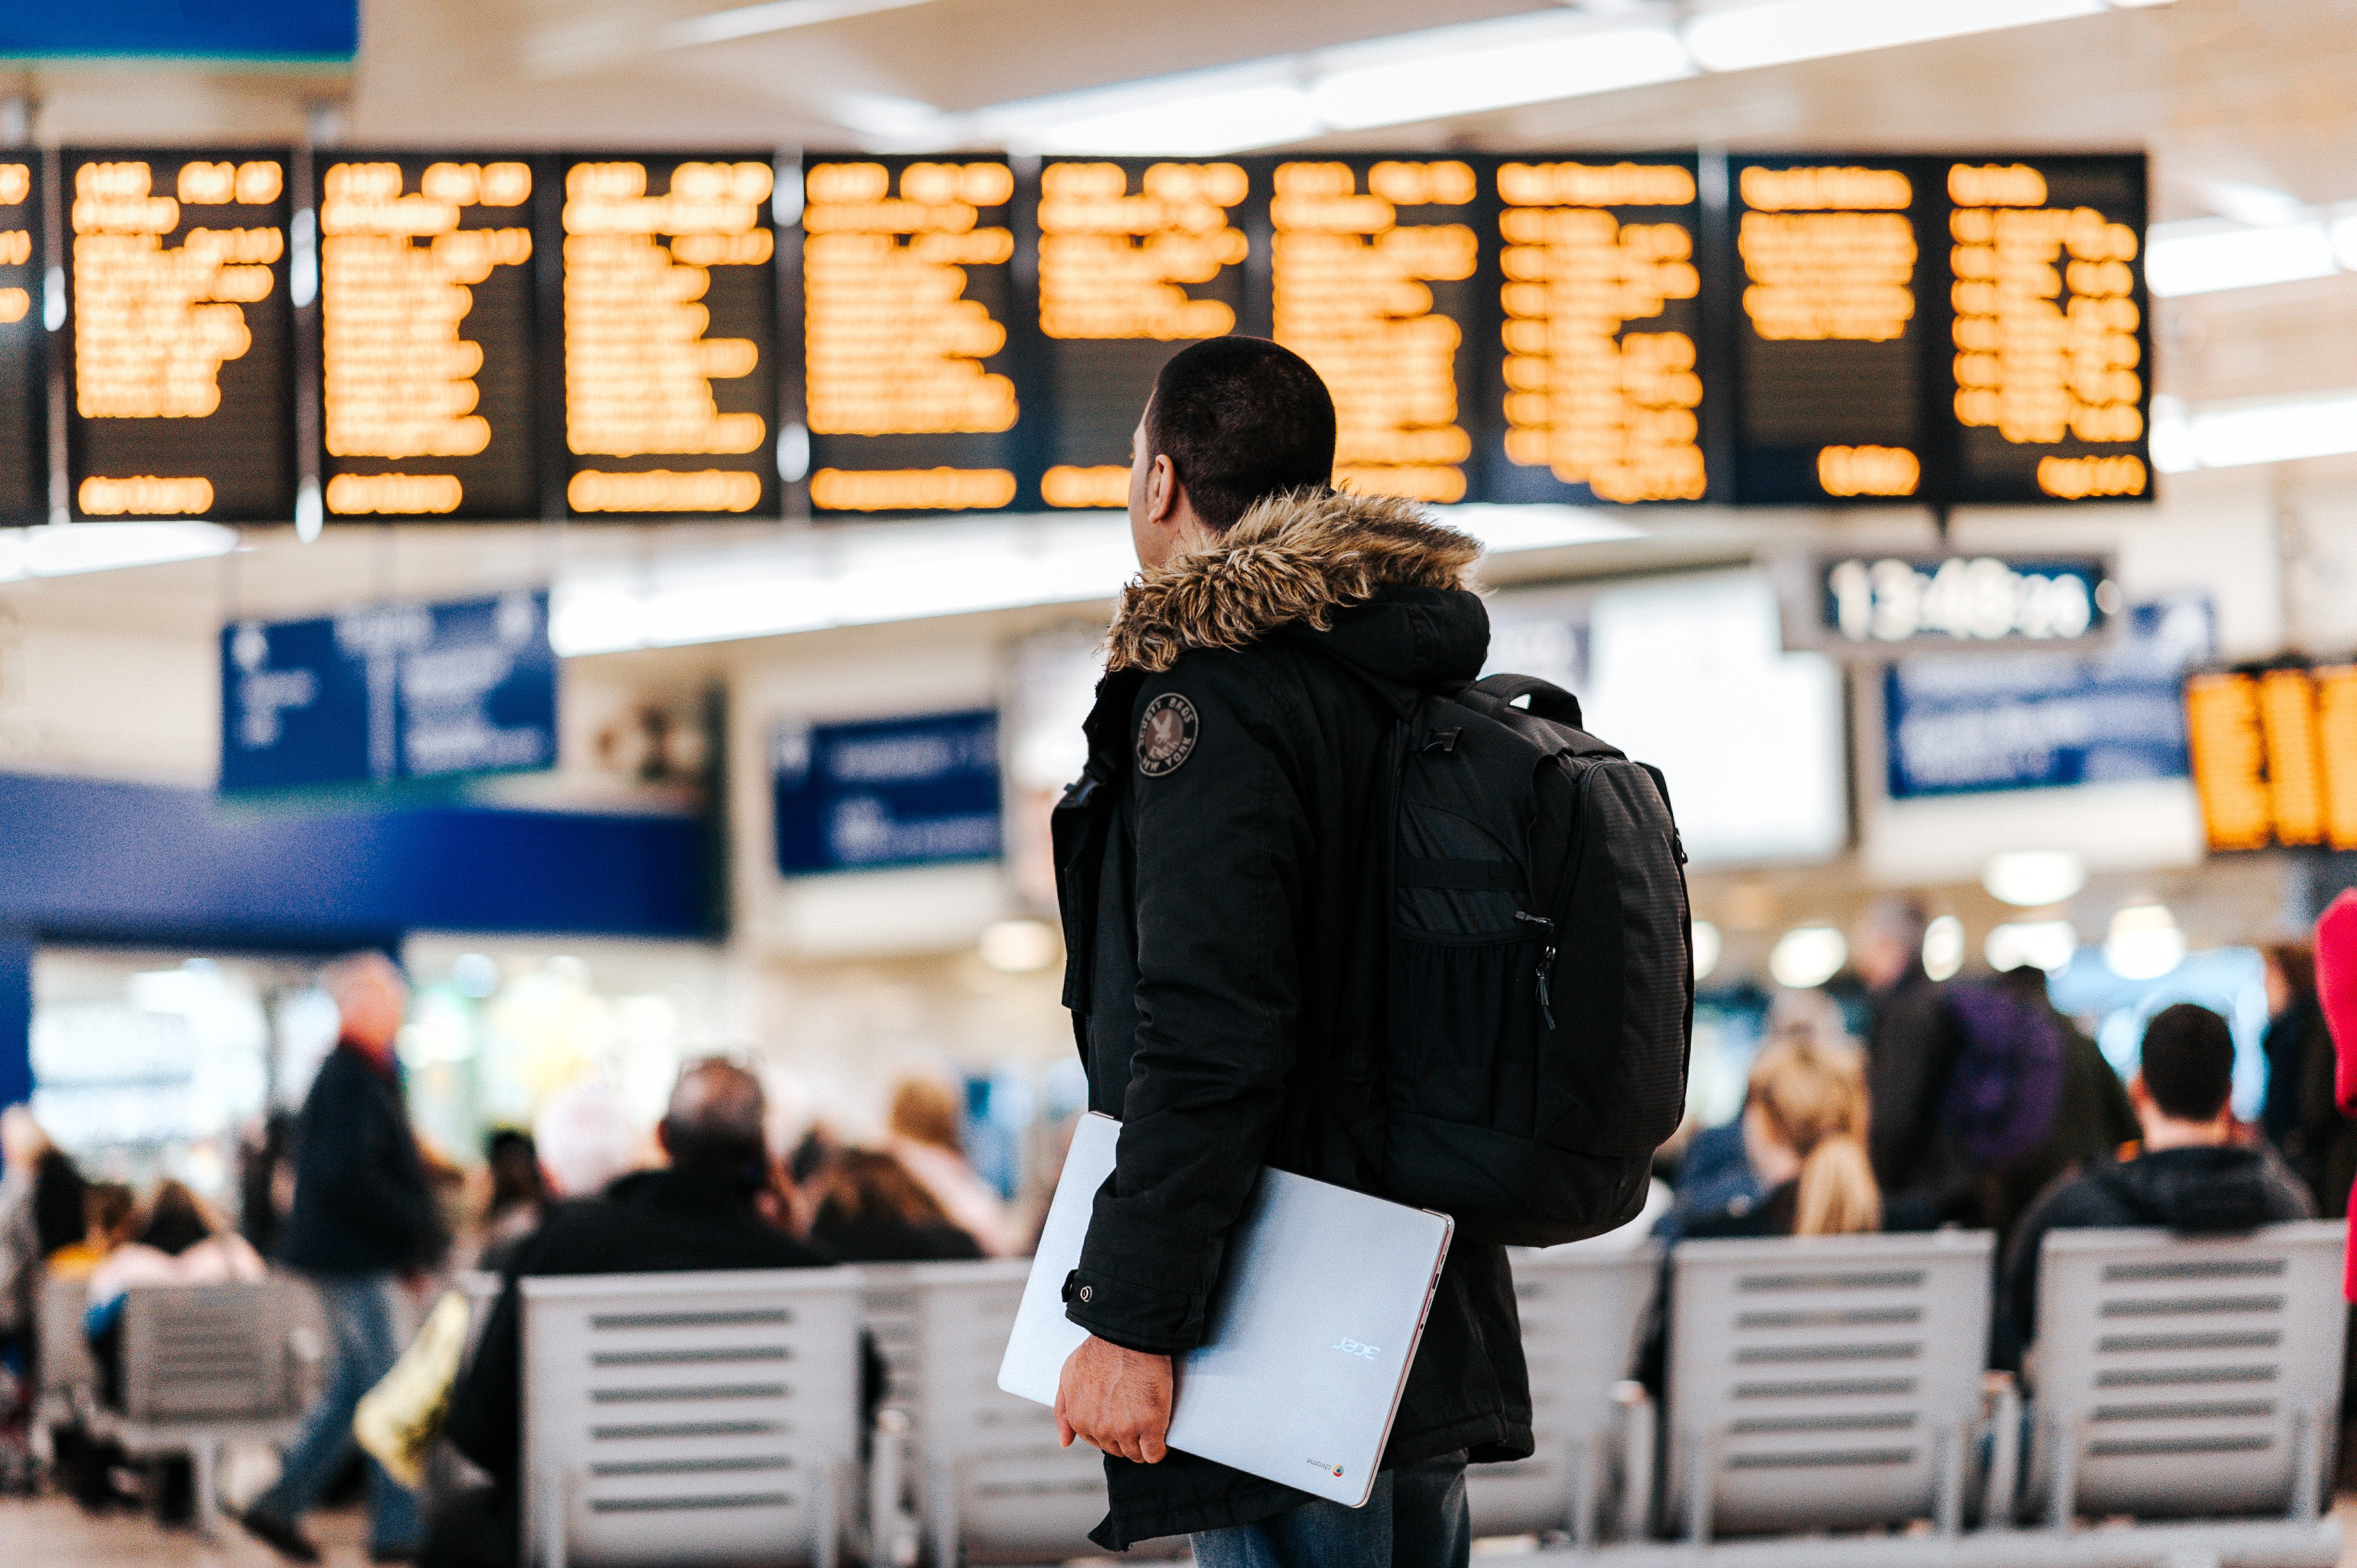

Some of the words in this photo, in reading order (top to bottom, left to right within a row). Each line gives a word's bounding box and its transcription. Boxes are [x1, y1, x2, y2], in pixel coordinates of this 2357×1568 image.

[1139, 701, 1162, 746] SCHOTT
[1169, 698, 1194, 724] BROS
[1165, 736, 1192, 767] YORK
[1332, 1337, 1381, 1360] acer
[1306, 1458, 1331, 1471] chrome
